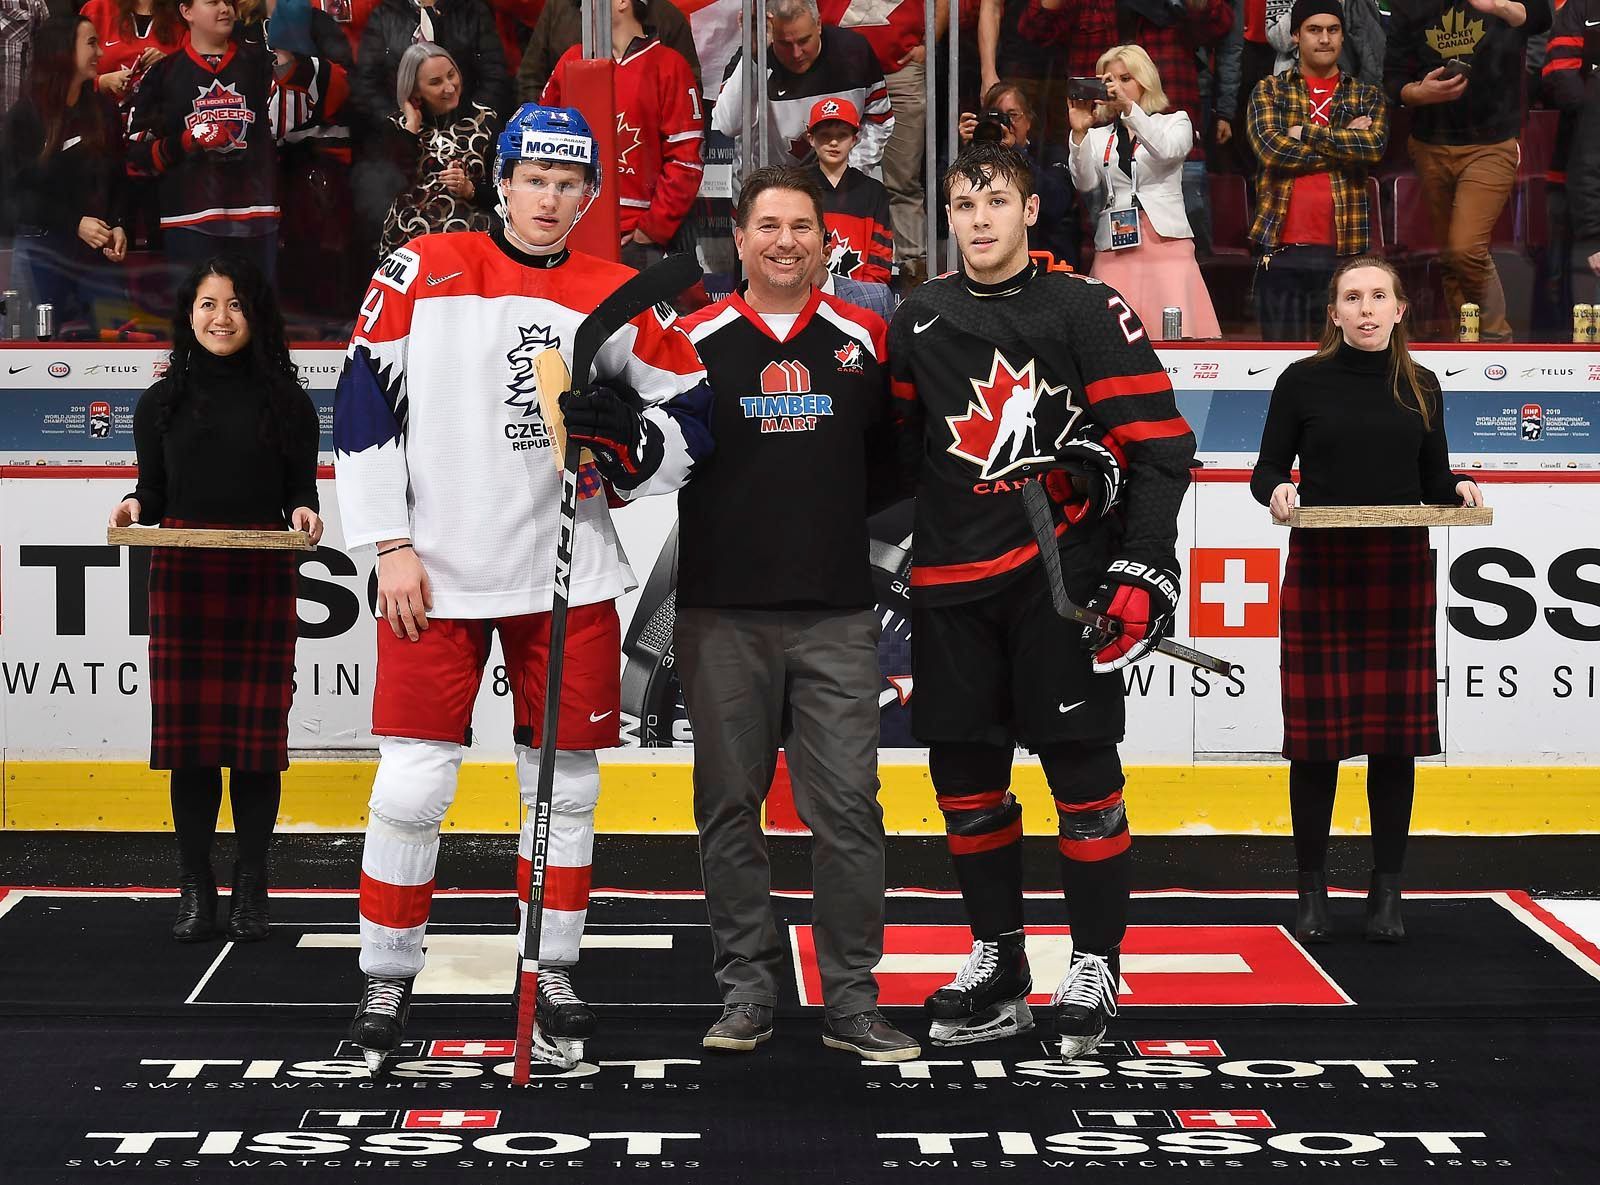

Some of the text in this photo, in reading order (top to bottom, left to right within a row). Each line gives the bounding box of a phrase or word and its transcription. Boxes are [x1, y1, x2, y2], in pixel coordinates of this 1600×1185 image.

[1437, 29, 1474, 41] HOCKEY
[1438, 38, 1475, 49] CANADA
[185, 109, 256, 128] PIONEERS
[525, 141, 588, 159] MOGUL
[1107, 295, 1144, 344] 2
[104, 365, 138, 373] TELUS
[1541, 368, 1574, 376] TELUS
[740, 395, 833, 418] TIMBER
[761, 416, 817, 433] MART
[139, 1059, 702, 1079] TISSOT
[860, 1060, 1419, 1078] TISSOT
[479, 1082, 595, 1090] SINCE
[865, 1081, 1440, 1090] SWISS WATCHES SINCE 1853
[85, 1131, 701, 1155] TISSOT
[876, 1131, 1488, 1155] TISSOT
[65, 1159, 700, 1168] SWISS WATCHES SINCE 1853
[882, 1159, 1513, 1168] SWISS WATCHES SINCE 1853
